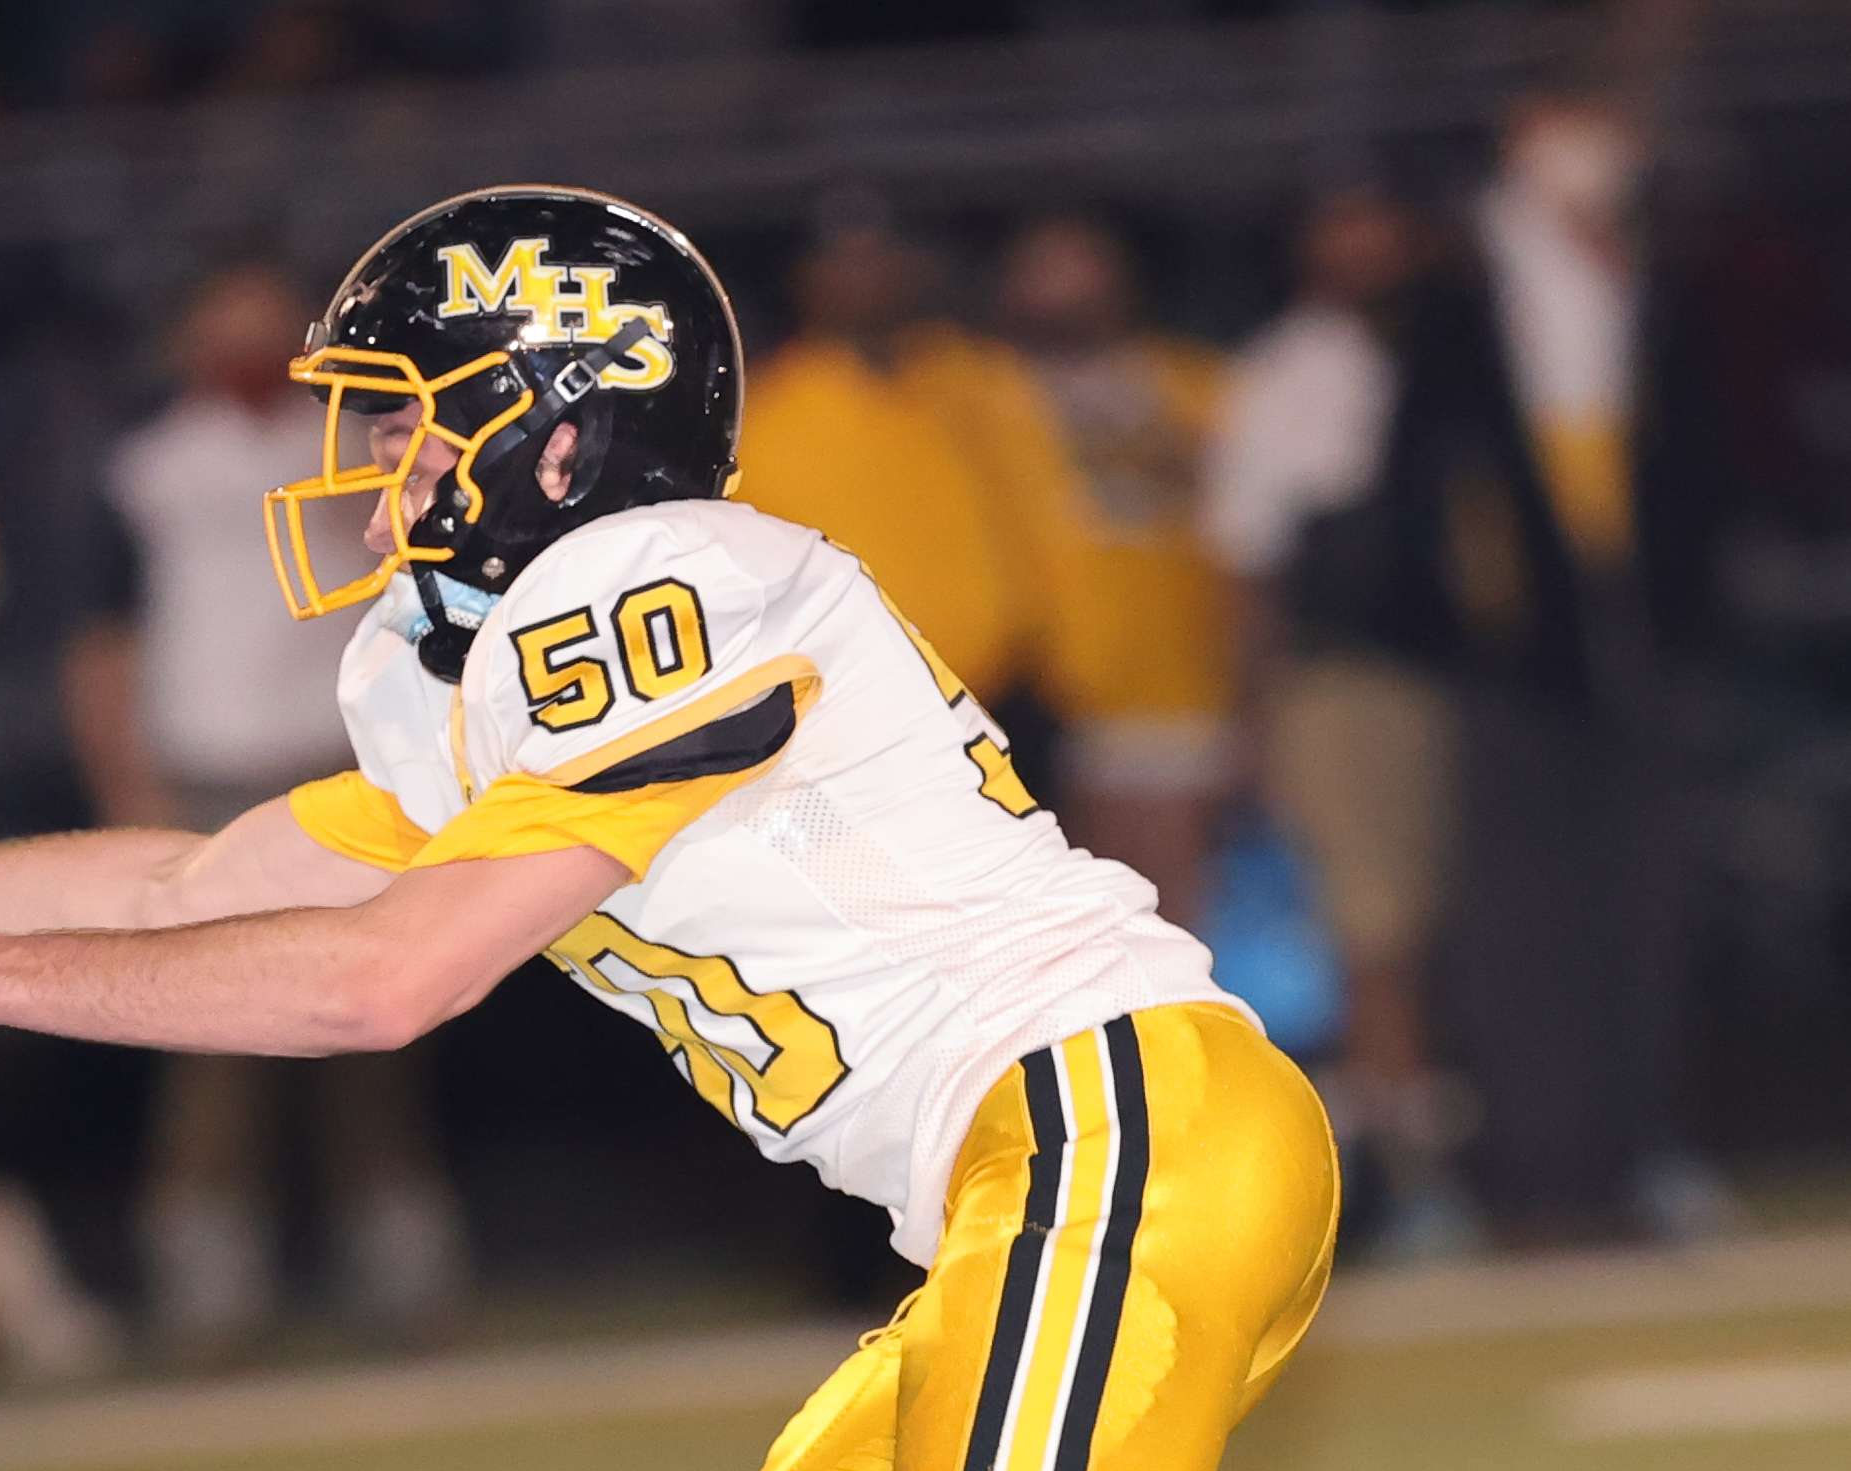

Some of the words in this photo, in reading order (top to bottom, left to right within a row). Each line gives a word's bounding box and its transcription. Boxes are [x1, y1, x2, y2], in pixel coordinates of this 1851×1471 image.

[437, 238, 674, 390] MHS
[508, 576, 713, 734] 50
[544, 909, 852, 1137] 0
